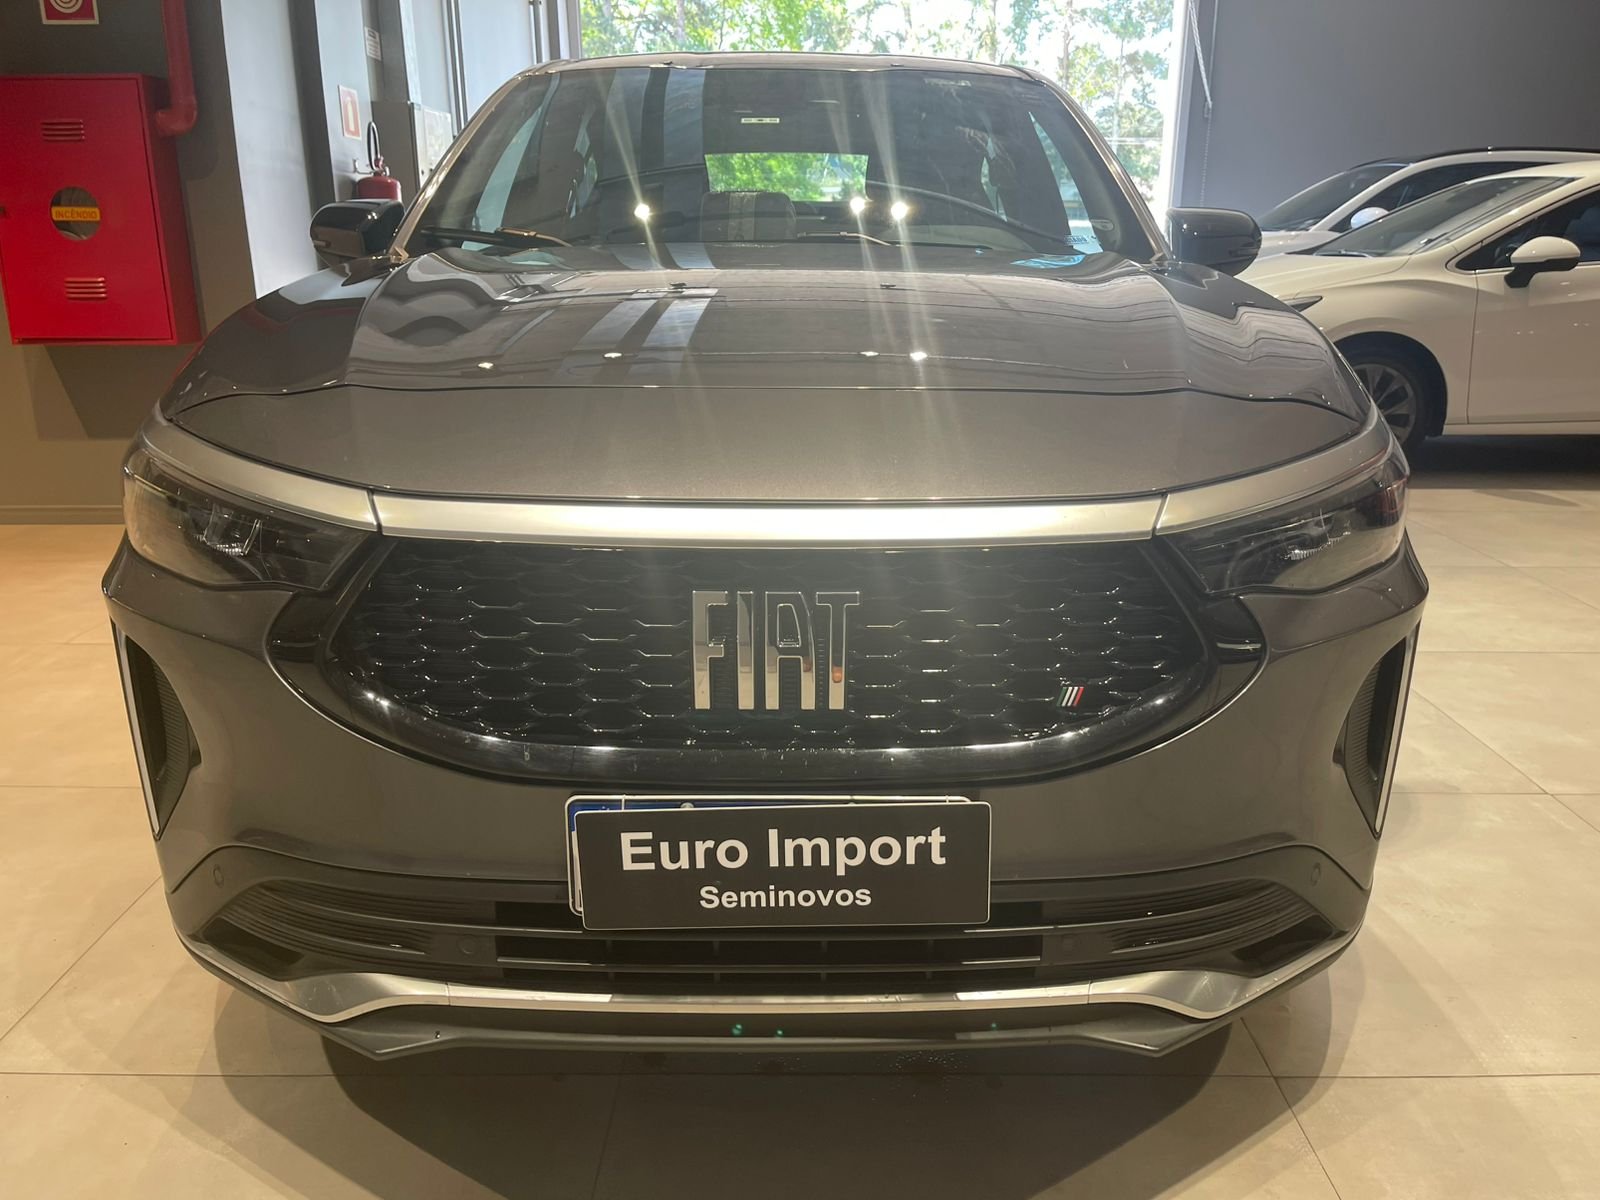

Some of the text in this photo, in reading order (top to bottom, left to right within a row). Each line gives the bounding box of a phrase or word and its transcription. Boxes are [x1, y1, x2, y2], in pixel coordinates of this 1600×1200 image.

[692, 590, 860, 710] FIAT
[620, 826, 947, 876] Euro Import
[699, 885, 872, 909] Seminovos
